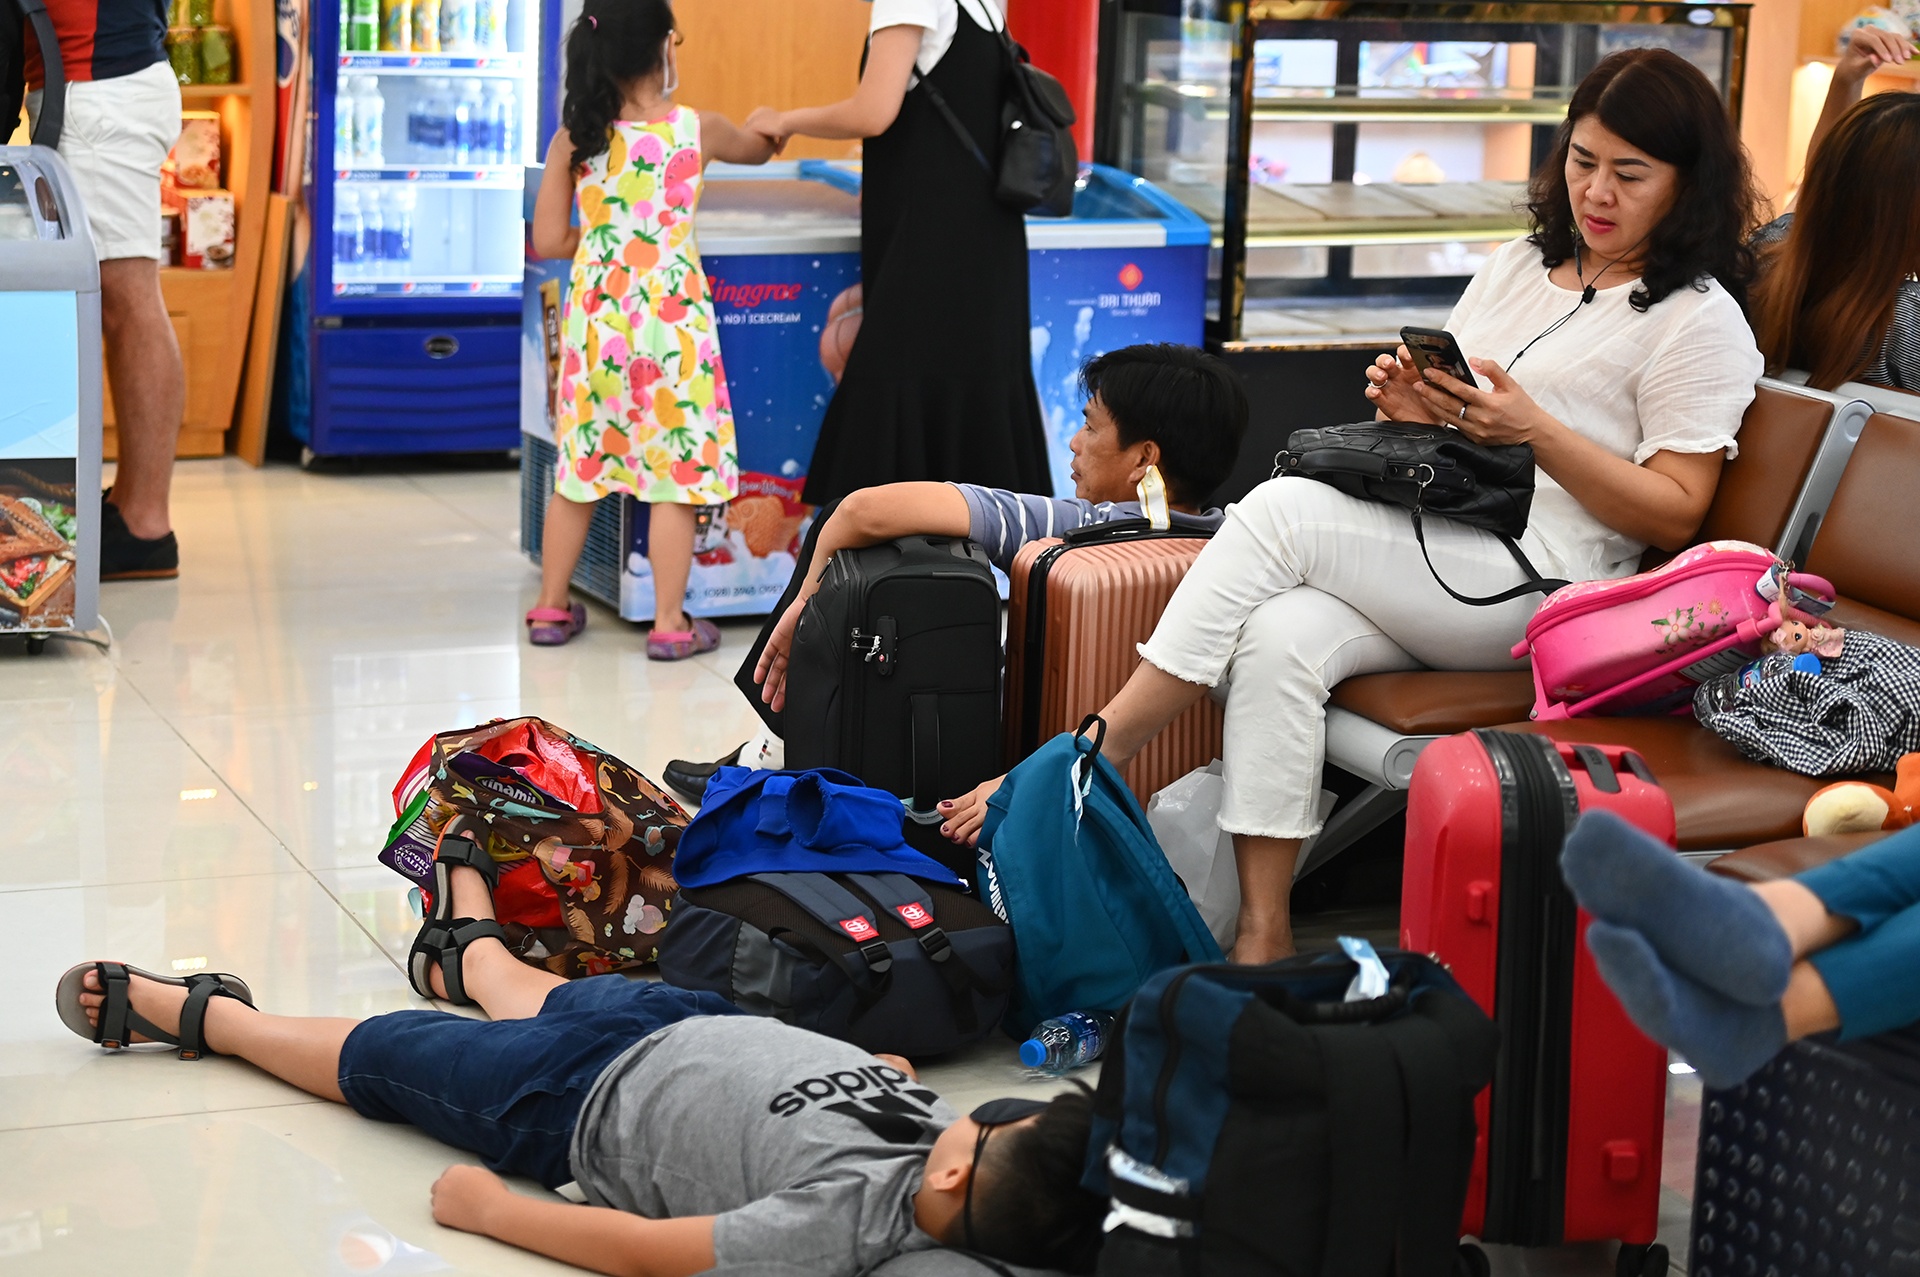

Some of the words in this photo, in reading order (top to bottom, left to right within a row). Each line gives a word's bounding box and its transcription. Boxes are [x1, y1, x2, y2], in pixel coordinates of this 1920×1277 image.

[394, 849, 429, 875] QUALITY
[397, 846, 431, 869] EXPORT
[769, 1065, 908, 1118] adidas
